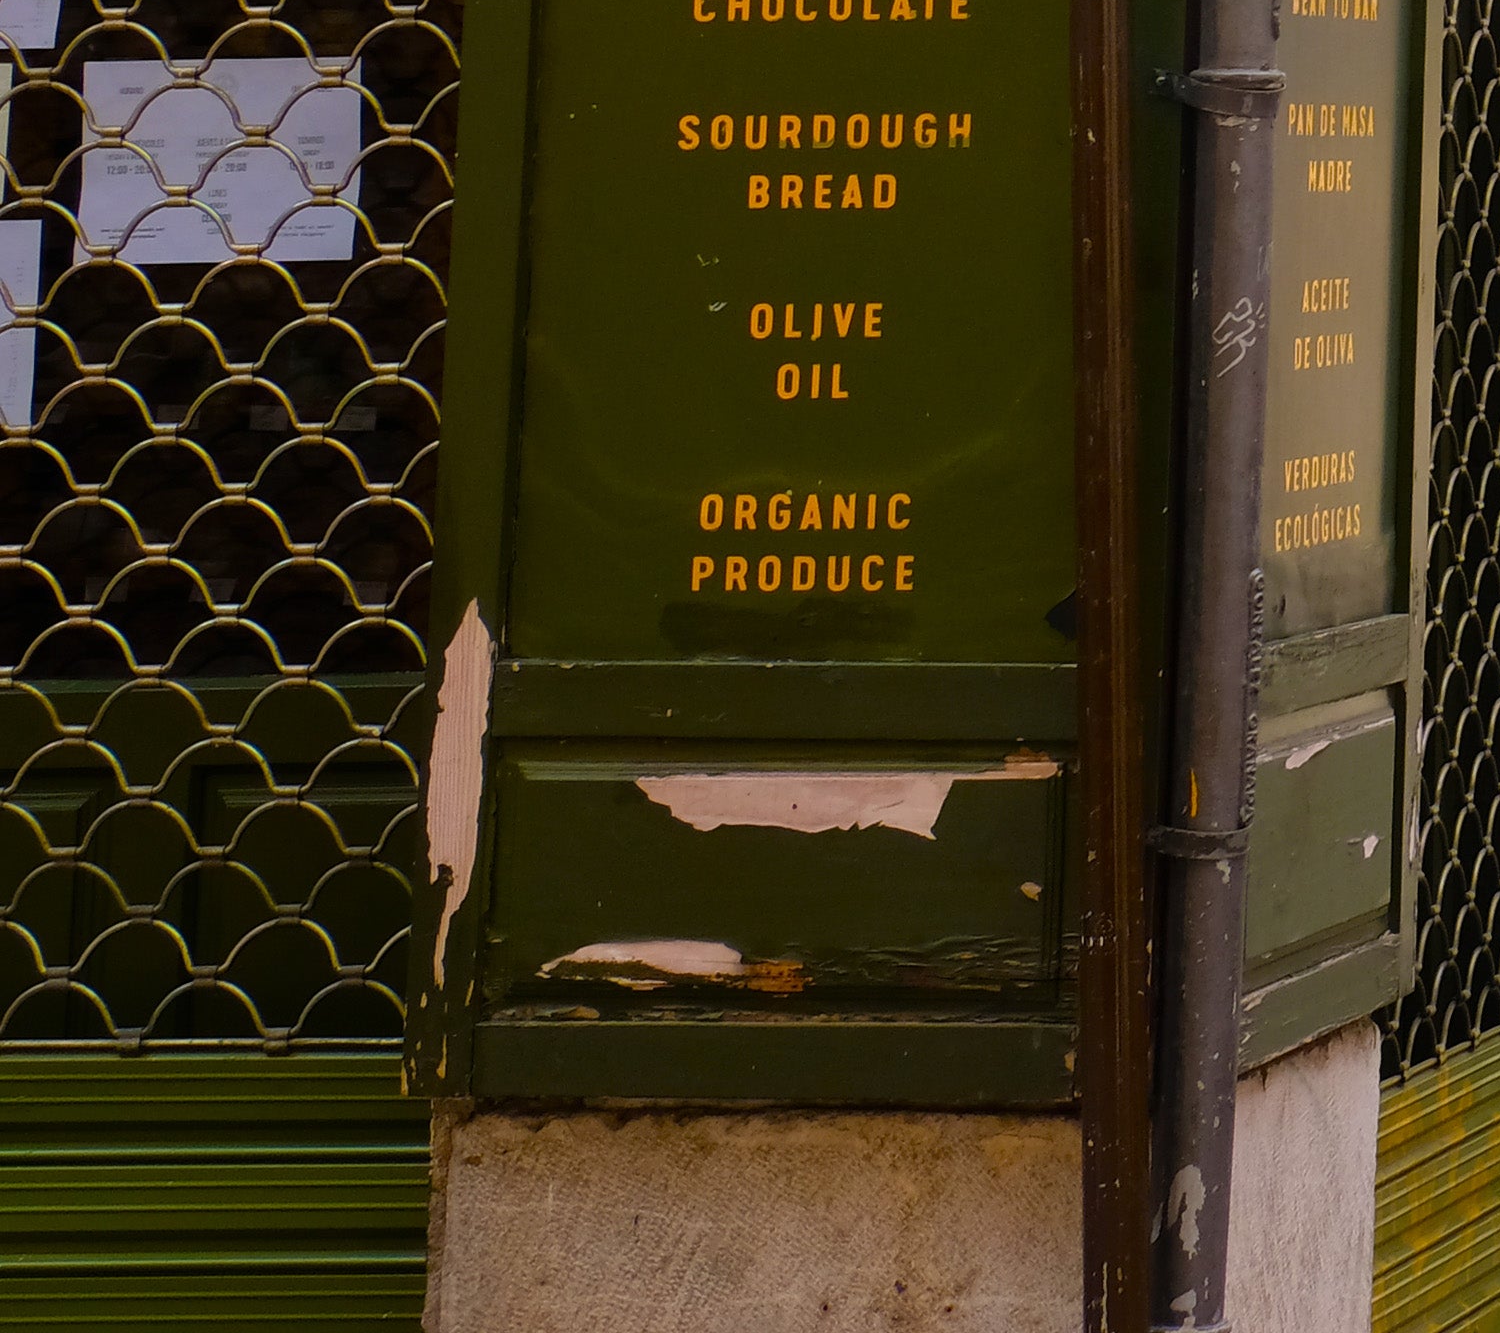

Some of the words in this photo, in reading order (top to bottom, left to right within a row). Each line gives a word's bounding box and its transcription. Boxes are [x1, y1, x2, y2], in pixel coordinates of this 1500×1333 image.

[678, 113, 972, 150] SOURDOUGH
[1287, 103, 1315, 137] PAN
[1319, 103, 1337, 137] DE
[1341, 105, 1375, 138] MASA
[748, 174, 898, 209] BREAD
[1308, 160, 1352, 193] MADRE
[1301, 277, 1351, 314] ACEITE
[750, 302, 884, 341] OLIVE
[1294, 336, 1312, 371] DE
[1315, 332, 1355, 368] OLIVA
[776, 363, 849, 399] OIL
[1284, 450, 1356, 493] VERDURAS
[700, 492, 913, 531] ORGANIC
[1275, 503, 1361, 552] ECOLÓGICAS
[691, 554, 914, 592] PRODUCE
